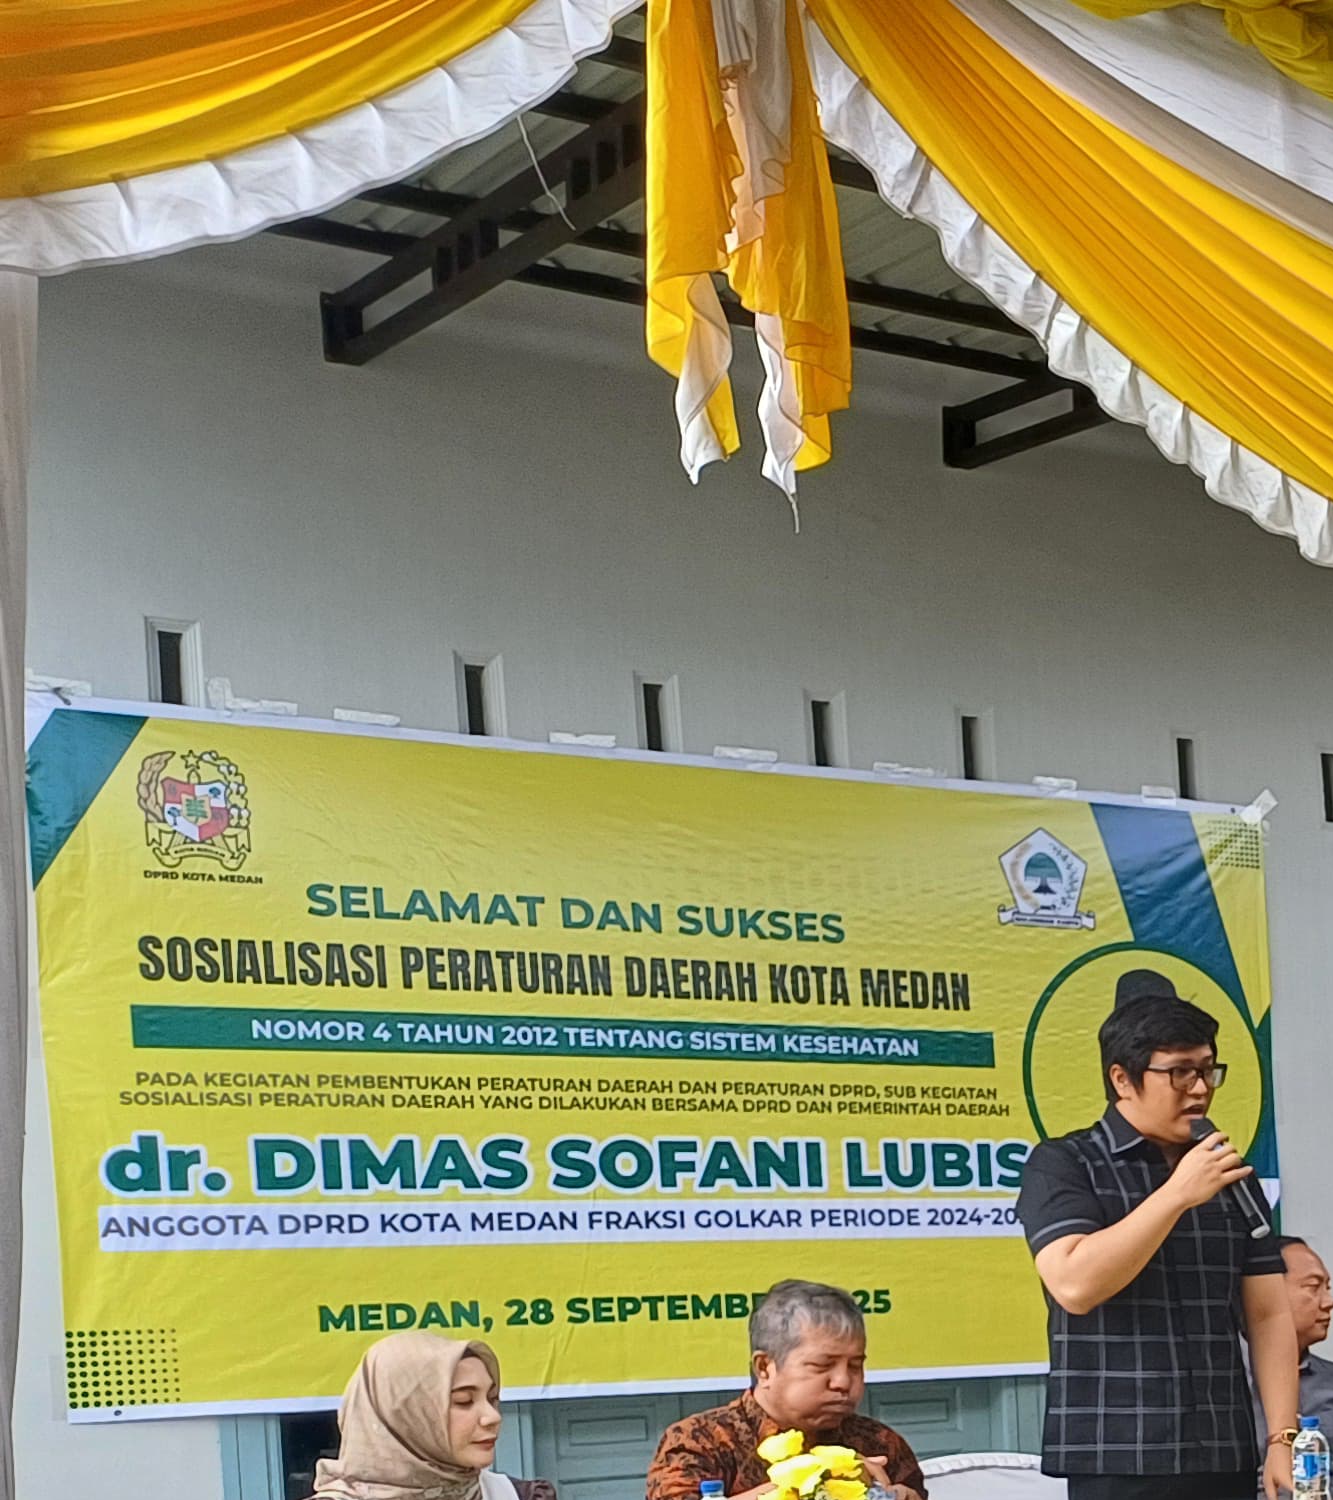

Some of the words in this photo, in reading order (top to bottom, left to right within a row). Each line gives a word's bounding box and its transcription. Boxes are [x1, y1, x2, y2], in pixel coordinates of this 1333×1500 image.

[144, 870, 179, 880] DPRD
[182, 872, 216, 882] KOTA
[219, 874, 263, 884] MEDAN
[306, 882, 545, 928] SELAMAT
[560, 897, 663, 934] DAN
[678, 904, 845, 944] SUKSES
[137, 935, 388, 988] SOSIALISASI
[400, 945, 613, 997] PERATURAN
[624, 955, 758, 1003] DAERAH
[768, 963, 851, 1006] KOTA
[860, 968, 971, 1012] MEDAN
[251, 1018, 365, 1043] NOMOR
[372, 1022, 392, 1042] 4
[397, 1022, 494, 1045] TAHUN
[501, 1025, 558, 1047] 2012
[563, 1026, 684, 1051] TENTANG
[689, 1030, 777, 1053] SISTEM
[782, 1033, 919, 1057] KESEHATAN
[119, 1090, 253, 1106] SOSIALISASI
[259, 1092, 385, 1108] PERATURAN
[391, 1094, 475, 1109] DAERAH
[479, 1094, 534, 1110] YANG
[538, 1096, 646, 1111] DILAKUKAN
[652, 1097, 738, 1113] BERSAMA
[742, 1099, 791, 1114] DPRD
[796, 1100, 832, 1114] DAN
[837, 1101, 942, 1116] PEMERINTAH
[945, 1102, 1010, 1117] DAERAH
[135, 1071, 198, 1087] PADA
[204, 1072, 311, 1089] KEGIATAN
[317, 1074, 471, 1090] PEMBENTUKAN
[477, 1076, 592, 1093] PERATURAN
[598, 1079, 673, 1094] DAERAH
[679, 1080, 717, 1095] DAN
[722, 1081, 824, 1097] PERATURAN
[829, 1084, 881, 1100] DPRD,
[883, 1085, 917, 1099] SUB
[920, 1086, 997, 1100] KEGIATAN
[105, 1134, 227, 1192] dr.
[252, 1137, 529, 1191] DIMAS
[550, 1138, 824, 1190] SOFANI
[845, 1142, 1028, 1188] LUBIS
[101, 1214, 269, 1238] ANGGOTA
[277, 1213, 370, 1235] DPRD
[380, 1212, 462, 1233] KOTA
[470, 1211, 578, 1232] MEDAN
[588, 1209, 685, 1231] FRAKSI
[694, 1208, 802, 1229] GOLKAR
[810, 1208, 921, 1228] PERIODE
[926, 1207, 1018, 1226] 2024-20
[318, 1300, 494, 1333] MEDAN,
[504, 1298, 554, 1326] 28
[567, 1293, 769, 1324] SEPTEMB
[851, 1289, 892, 1314] 25
